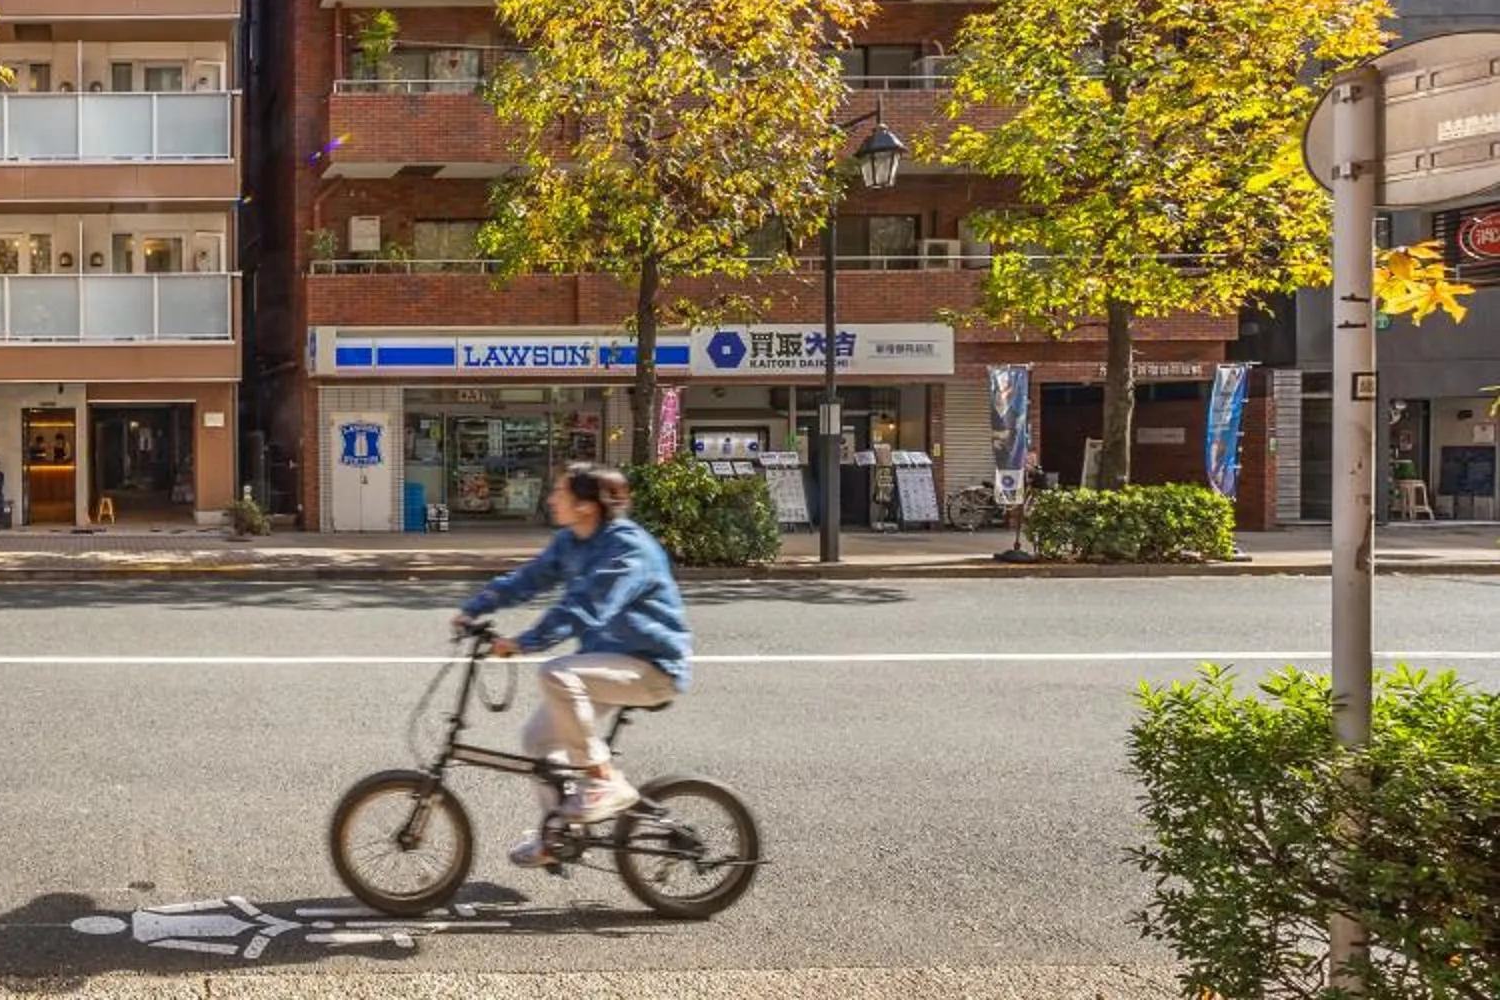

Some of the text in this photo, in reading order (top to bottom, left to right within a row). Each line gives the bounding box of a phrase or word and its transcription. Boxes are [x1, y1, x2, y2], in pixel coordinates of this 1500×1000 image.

[463, 345, 593, 367] LAWSON
[750, 332, 856, 358] 買取大吉
